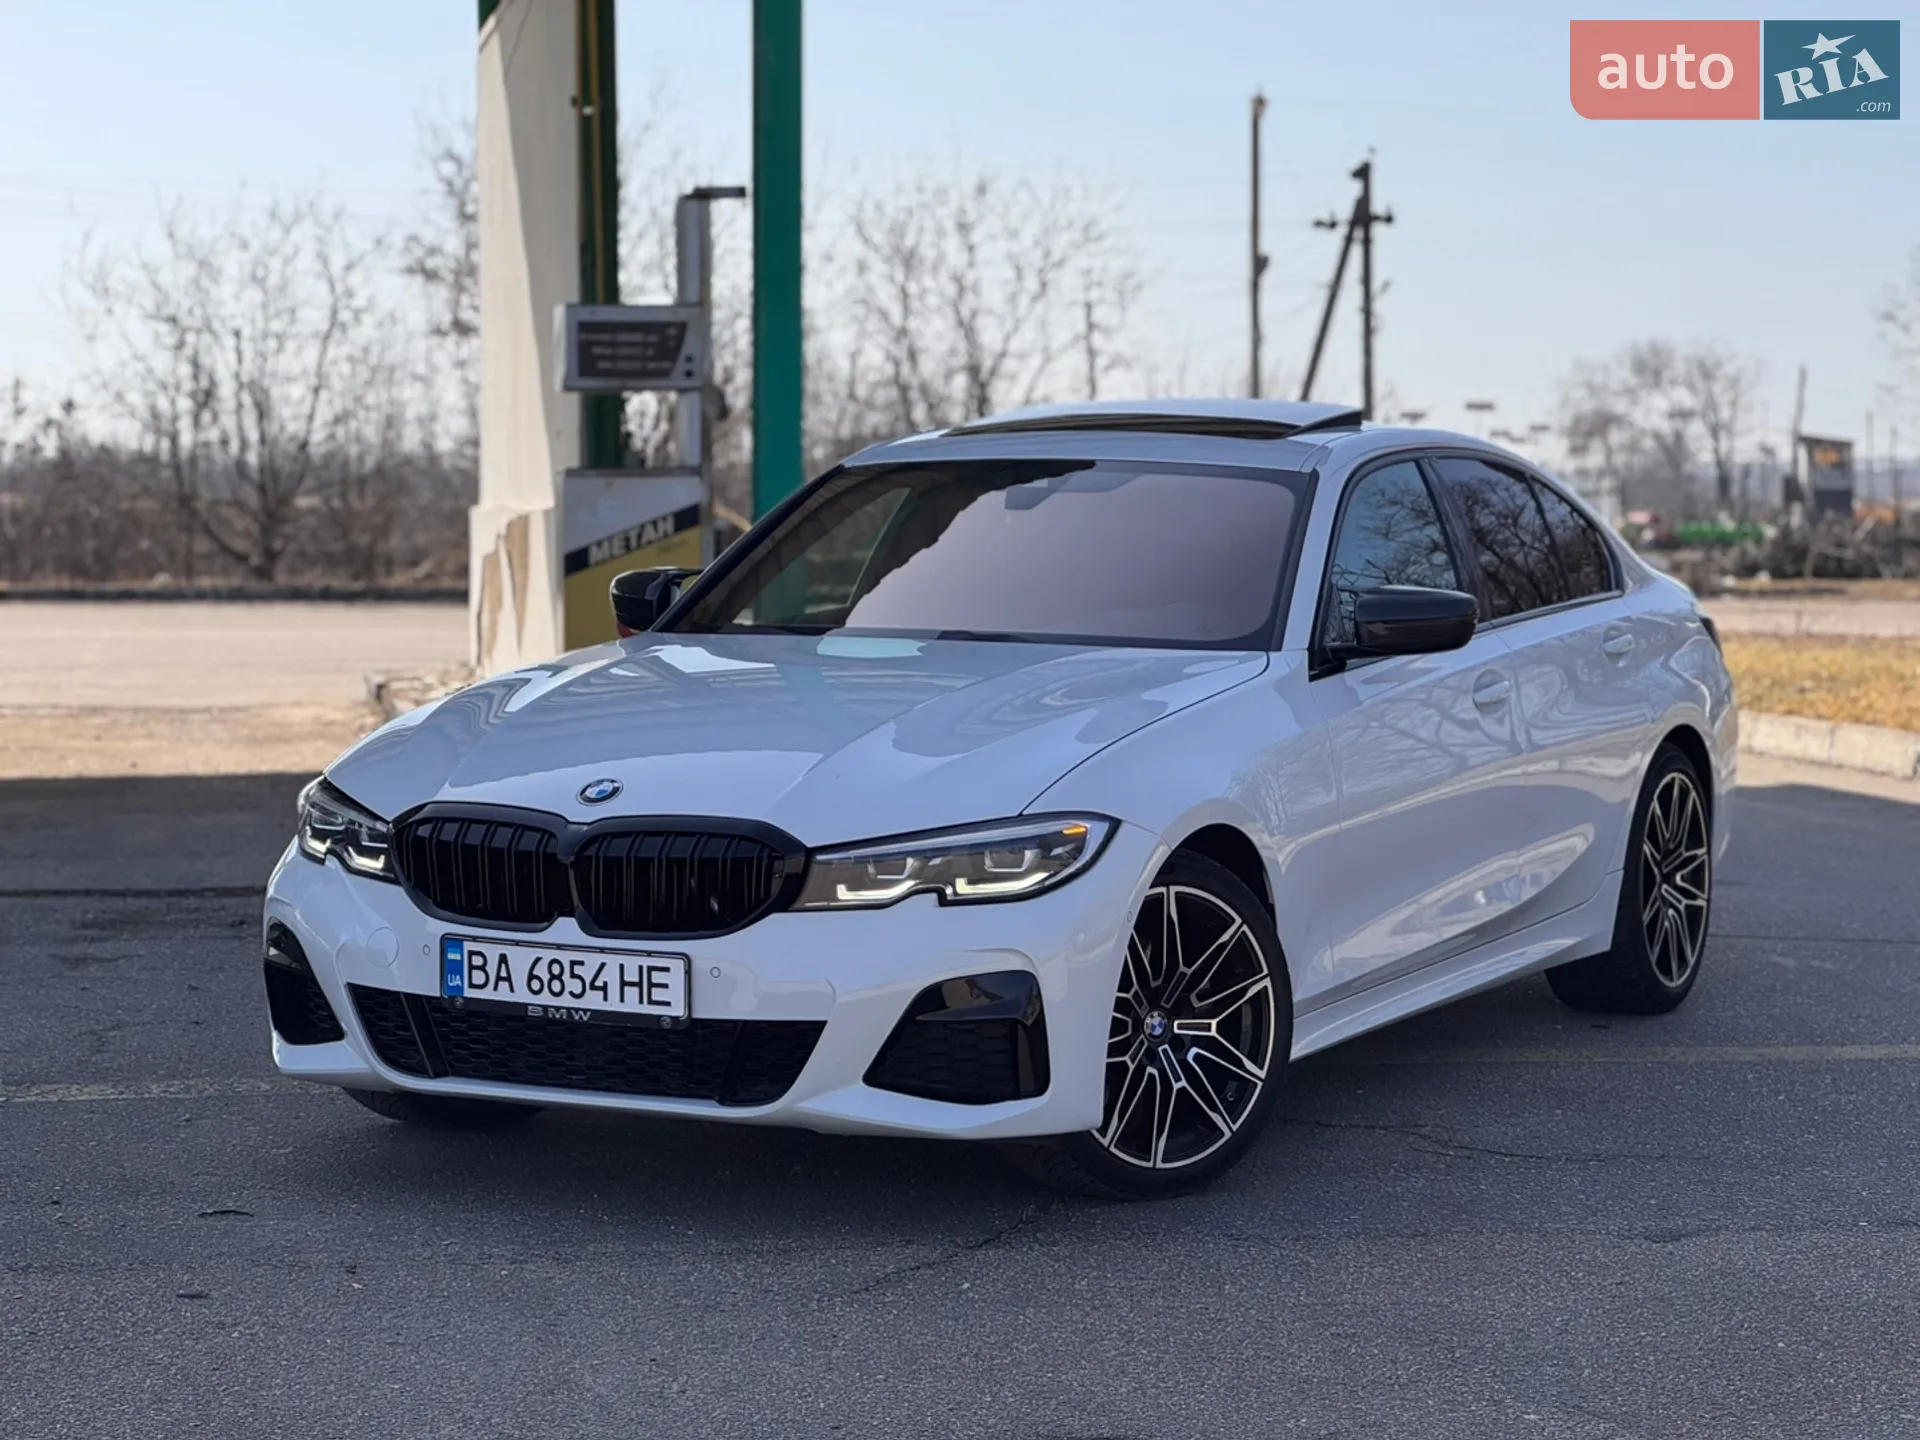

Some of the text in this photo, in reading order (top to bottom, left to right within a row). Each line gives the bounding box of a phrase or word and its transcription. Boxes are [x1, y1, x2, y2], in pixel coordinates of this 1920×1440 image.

[447, 974, 462, 987] UA
[467, 950, 671, 1006] BA 6854 HE
[527, 1006, 592, 1021] BMW
